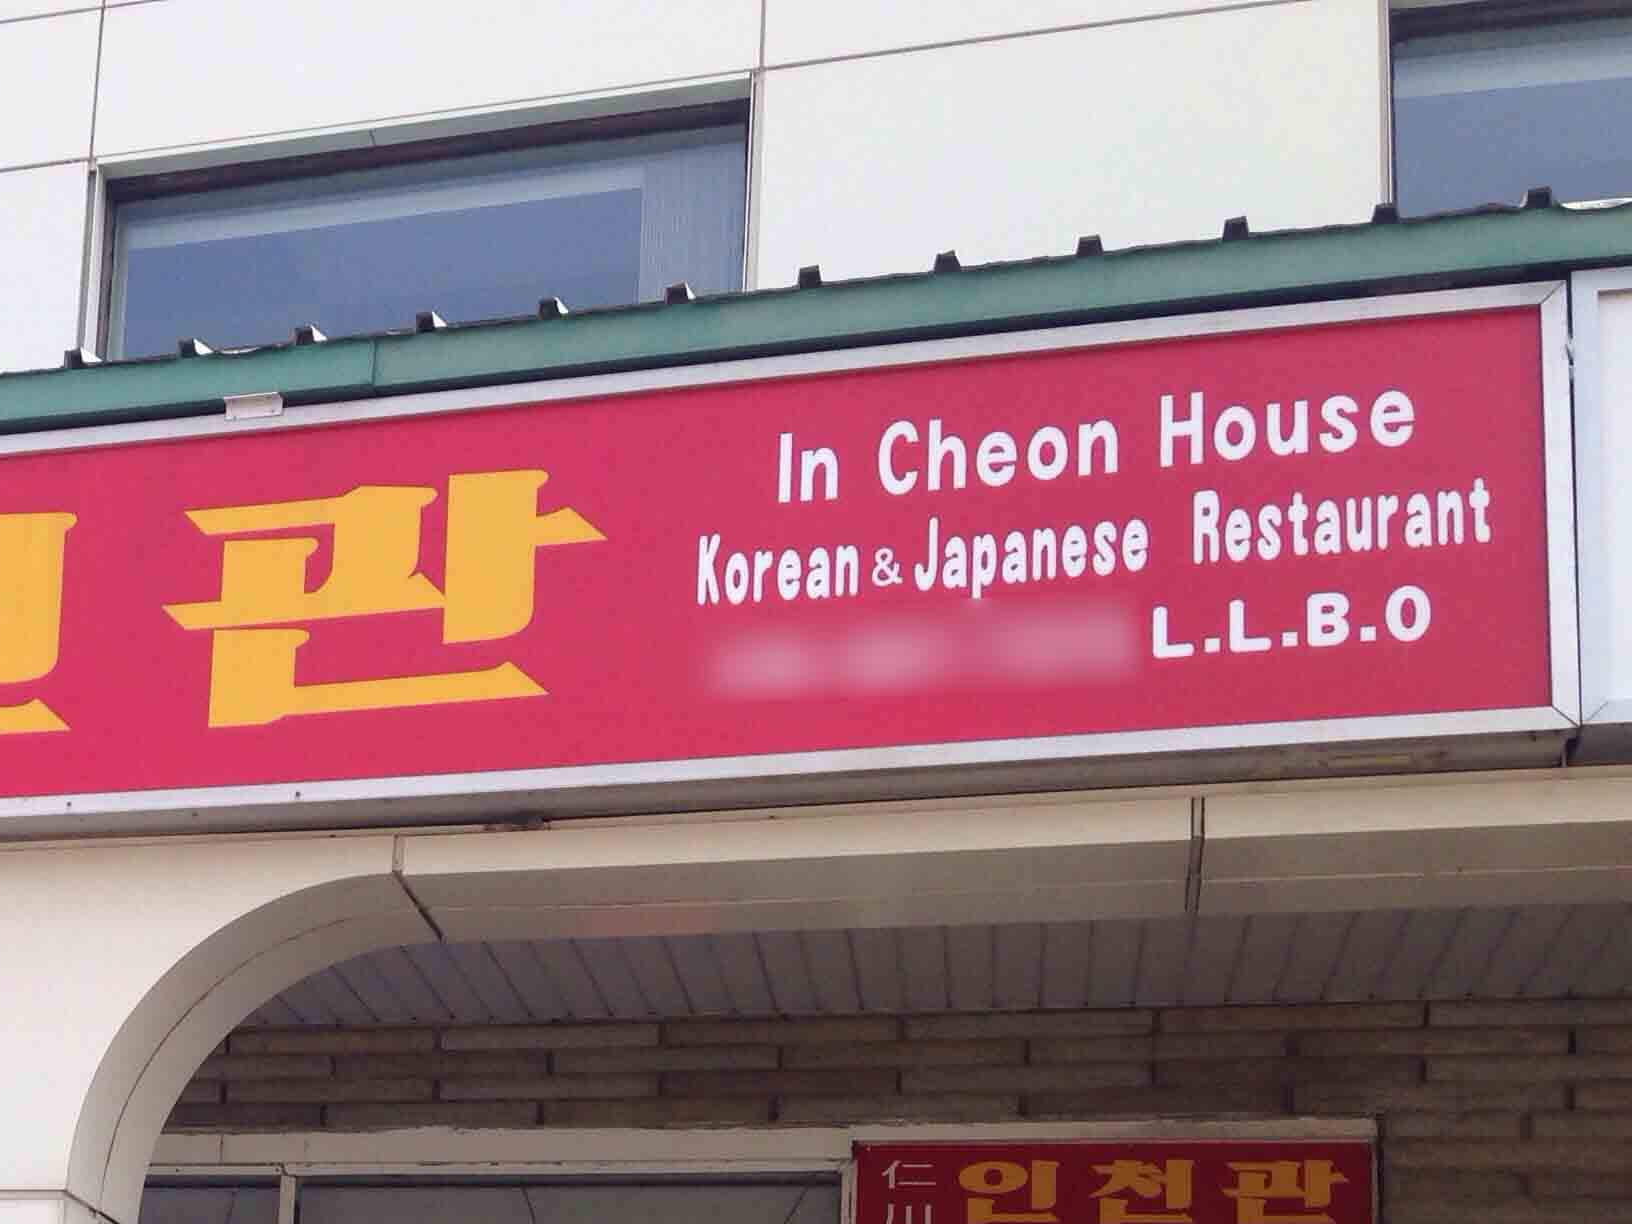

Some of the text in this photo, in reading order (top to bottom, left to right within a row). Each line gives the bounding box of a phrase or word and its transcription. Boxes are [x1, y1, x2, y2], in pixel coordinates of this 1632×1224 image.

[778, 390, 1416, 503] In Cheon House
[696, 477, 1492, 606] Korean & Japanese Restaurant
[1153, 585, 1432, 658] L.L.B.O
